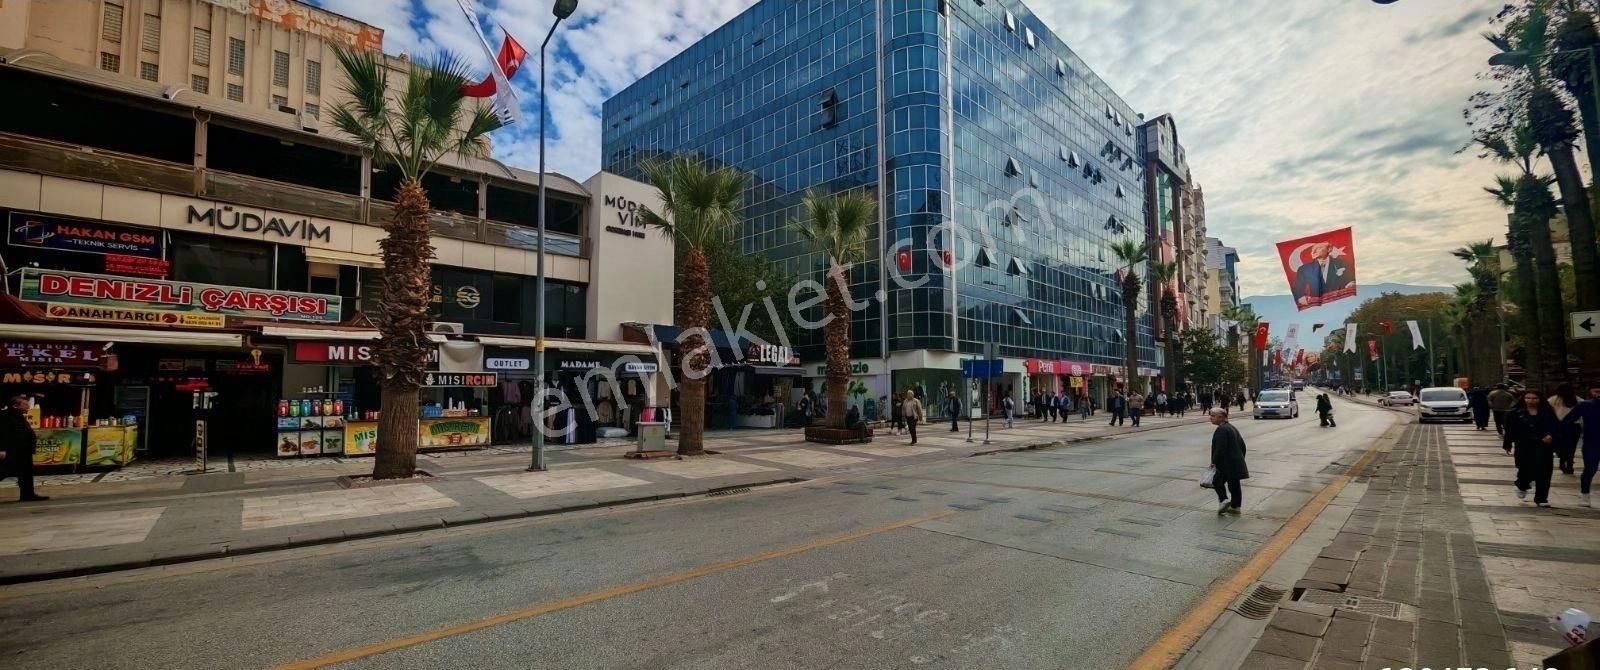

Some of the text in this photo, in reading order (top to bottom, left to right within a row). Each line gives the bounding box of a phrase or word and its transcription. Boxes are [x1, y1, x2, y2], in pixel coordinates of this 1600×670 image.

[188, 205, 331, 242] MÜDAVİM
[57, 225, 155, 245] HAKAN GSM
[72, 239, 138, 251] TEKNİK SERVİS
[40, 274, 327, 316] DENİZLİ ÇARŞISI
[68, 308, 159, 322] ANAHTARCI
[760, 344, 789, 364] LEGAL
[494, 360, 522, 368] OUTLET
[560, 361, 601, 369] MADAME
